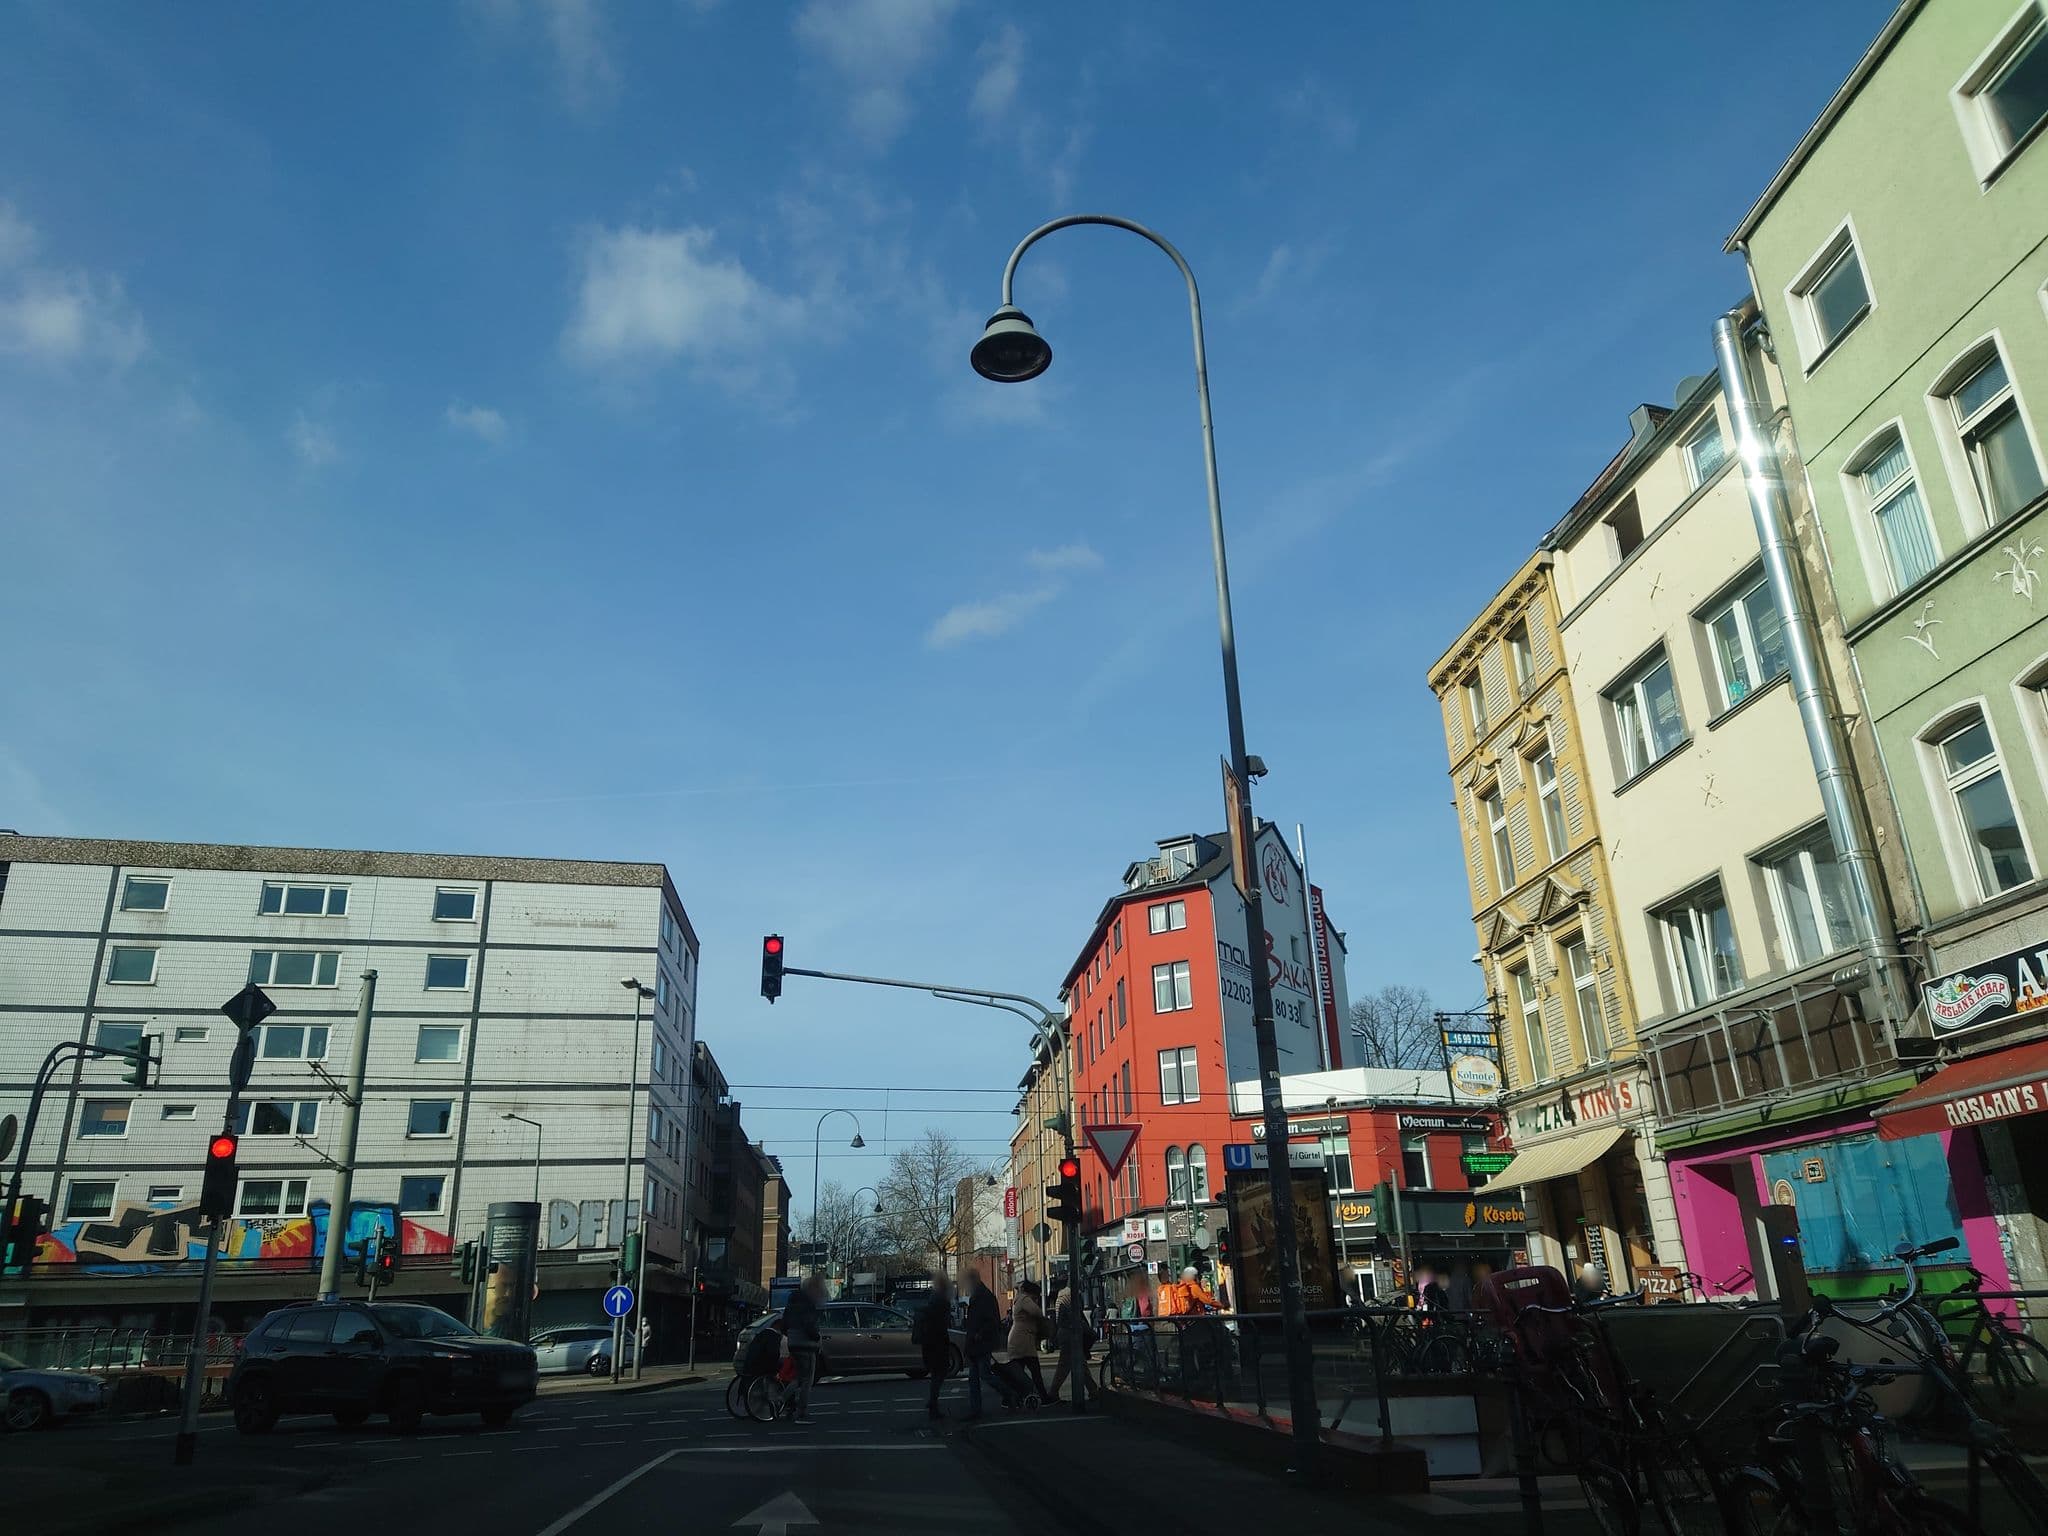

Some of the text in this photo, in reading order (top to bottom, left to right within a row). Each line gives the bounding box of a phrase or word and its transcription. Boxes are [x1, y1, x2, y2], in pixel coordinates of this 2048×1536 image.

[1218, 940, 1252, 970] mal
[1221, 977, 1252, 1005] 02203
[1975, 982, 2005, 999] KEBAP
[1944, 1085, 2038, 1126] ARSLAN'S
[1230, 1146, 1247, 1167] U
[1639, 1278, 1679, 1294] PIZZA
